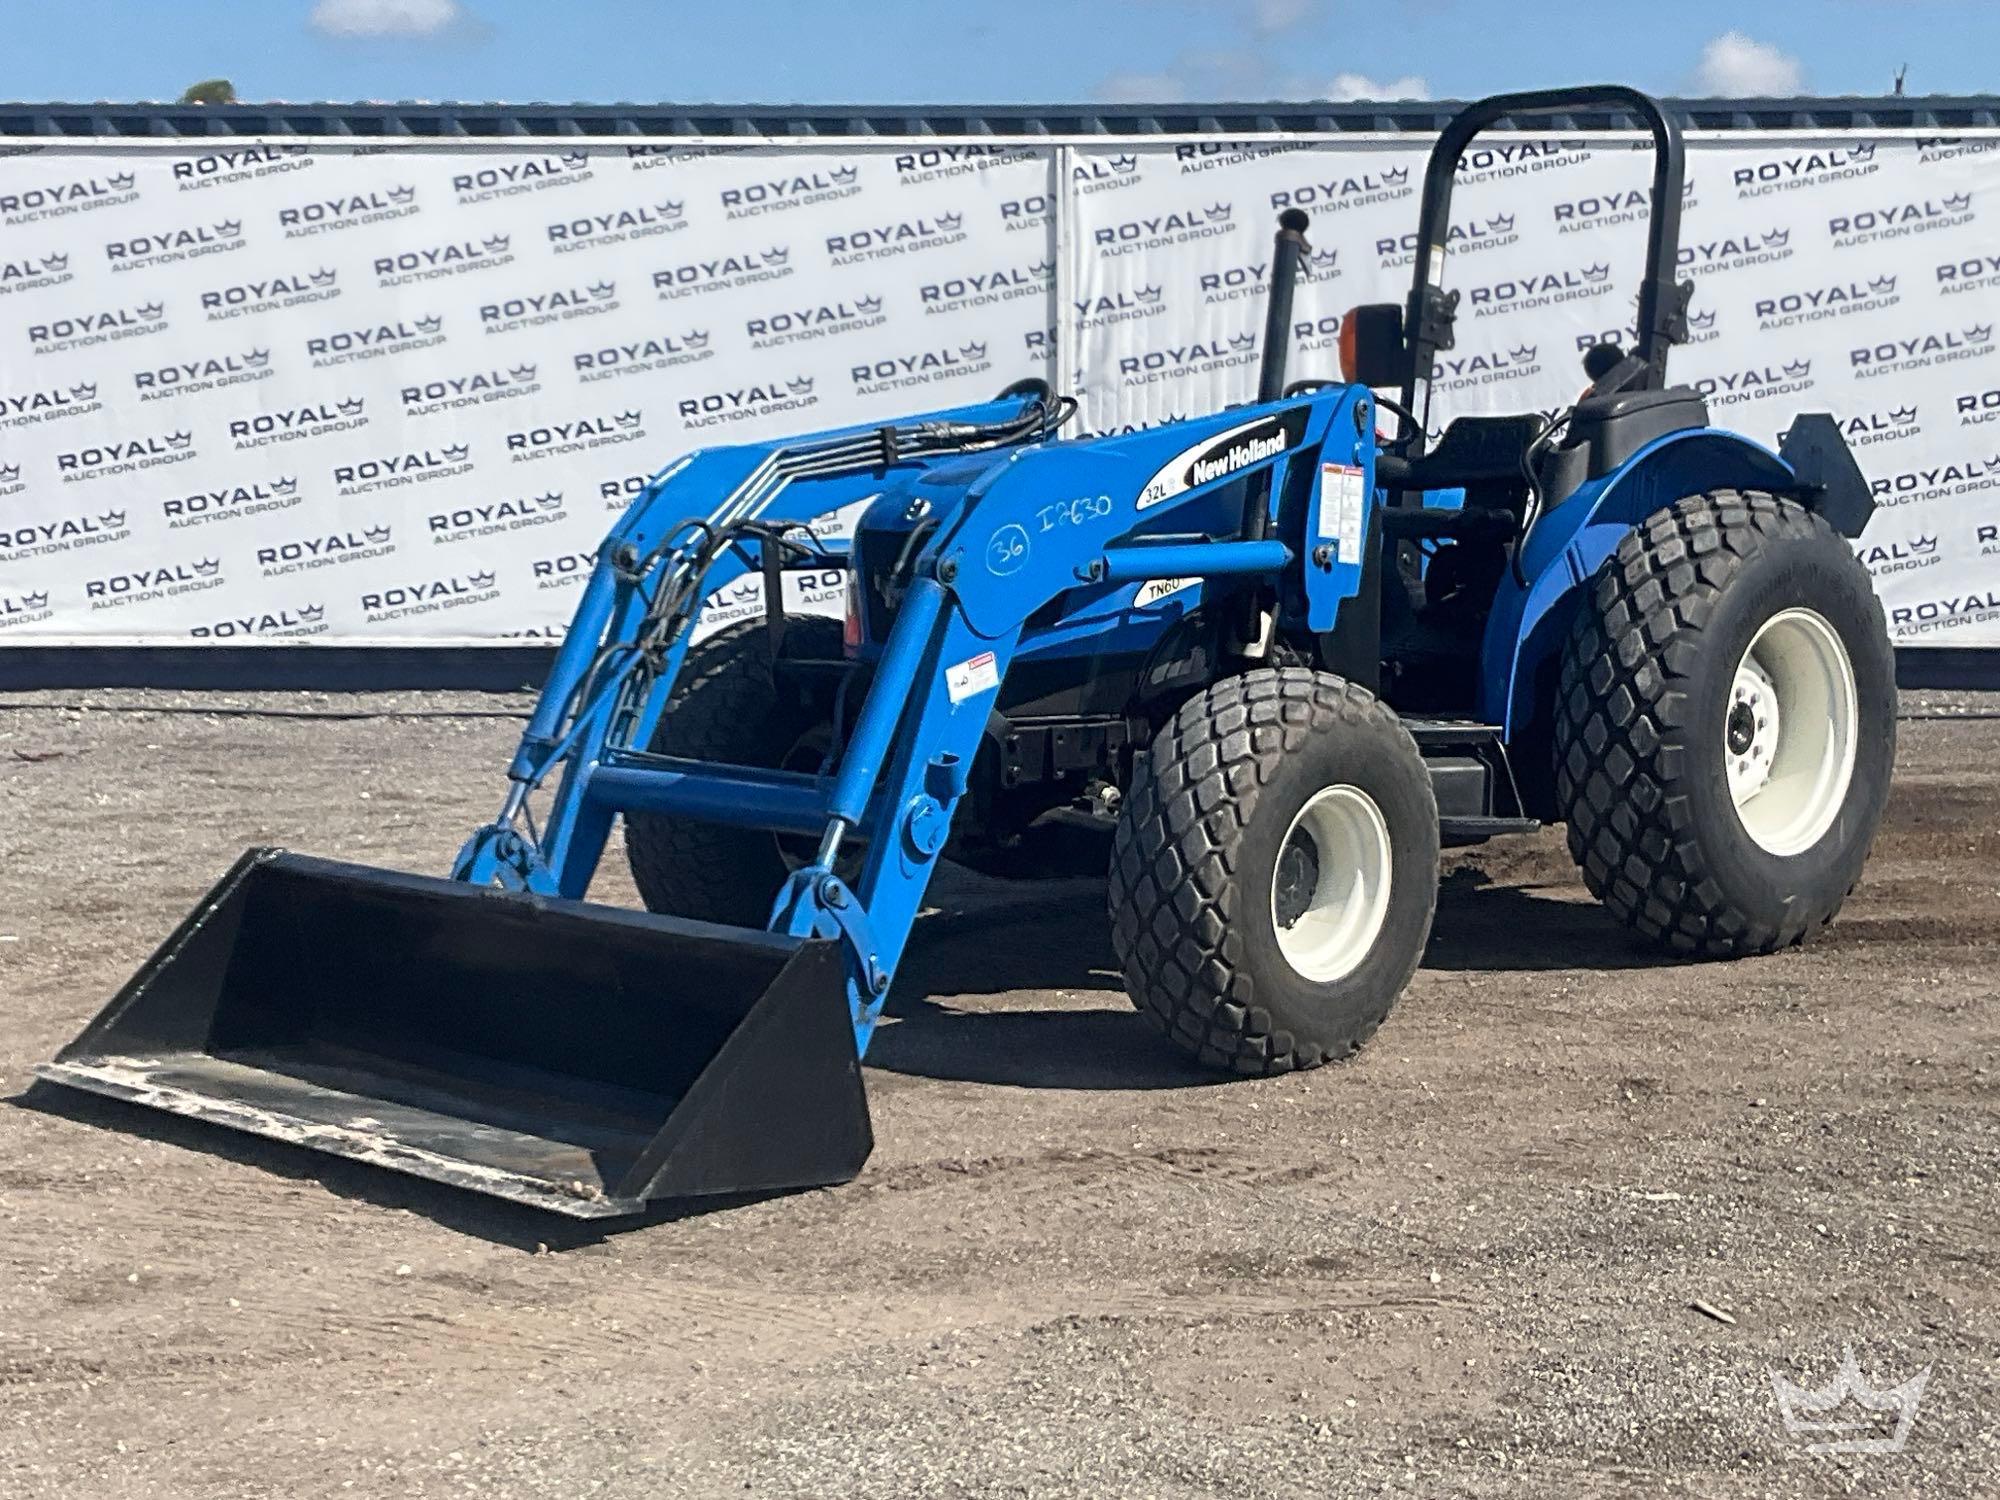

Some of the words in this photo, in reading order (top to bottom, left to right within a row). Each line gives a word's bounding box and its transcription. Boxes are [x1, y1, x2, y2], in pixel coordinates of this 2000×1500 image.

[173, 146, 281, 179] ROYAL
[178, 170, 254, 192] AUCTION
[255, 158, 314, 178] GROUP
[453, 158, 562, 192] ROYAL
[900, 164, 974, 187] AUCTION
[1181, 152, 1255, 175] AUCTION
[1531, 152, 1591, 172] GROUP
[1735, 152, 1846, 186] ROYAL
[0, 180, 108, 213] ROYAL
[458, 183, 534, 205] AUCTION
[535, 171, 594, 190] GROUP
[721, 174, 830, 207] ROYAL
[1083, 175, 1142, 194] GROUP
[1271, 175, 1381, 210] ROYAL
[1353, 187, 1412, 206] GROUP
[1740, 177, 1817, 199] AUCTION
[1819, 164, 1879, 184] GROUP
[4, 204, 80, 226] AUCTION
[81, 192, 140, 212] GROUP
[279, 192, 388, 226] ROYAL
[726, 198, 802, 220] AUCTION
[803, 186, 862, 206] GROUP
[1554, 188, 1653, 221] ROYA
[1829, 200, 1942, 235] ROYAL
[284, 217, 360, 239] AUCTION
[361, 205, 420, 224] GROUP
[548, 208, 656, 241] ROYAL
[553, 232, 628, 254] AUCTION
[630, 220, 689, 240] GROUP
[825, 220, 936, 254] ROYAL
[1094, 211, 1205, 245] ROYAL
[1558, 211, 1633, 234] AUCTION
[1834, 225, 1913, 248] AUCTION
[1914, 213, 1976, 233] GROUP
[106, 226, 214, 260] ROYAL
[111, 251, 186, 273] AUCTION
[188, 239, 247, 258] GROUP
[830, 245, 907, 267] AUCTION
[909, 232, 969, 252] GROUP
[1099, 236, 1176, 258] AUCTION
[1178, 223, 1238, 243] GROUP
[1376, 222, 1487, 257] ROAL
[1459, 234, 1519, 254] GROUP
[1677, 237, 1760, 266] OYAL
[374, 242, 482, 275] ROYAL
[379, 266, 454, 288] AUCTION
[456, 254, 515, 274] GROUP
[653, 254, 762, 288] ROYAL
[1677, 262, 1729, 279] CTION
[1733, 248, 1793, 268] GROUP
[16, 273, 73, 292] GROUP
[201, 276, 310, 309] ROYAL
[658, 279, 734, 301] AUCTION
[735, 267, 794, 286] GROUP
[920, 268, 1028, 302] ROYAL
[1470, 271, 1581, 305] ROYAL
[206, 300, 282, 322] AUCTION
[283, 288, 342, 308] GROUP
[480, 288, 588, 322] ROYAL
[925, 293, 1000, 315] AUCTION
[1075, 293, 1135, 316] YAL
[1108, 304, 1167, 324] GROUP
[1475, 296, 1552, 318] AUCTION
[1554, 283, 1614, 303] GROUP
[1755, 283, 1868, 318] ROYAL
[1760, 308, 1839, 331] AUCTION
[1840, 296, 1902, 316] GROUP
[28, 310, 136, 343] ROYAL
[485, 313, 560, 335] AUCTION
[562, 301, 621, 320] GROUP
[747, 304, 856, 337] ROYAL
[752, 328, 828, 350] AUCTION
[829, 316, 888, 336] GROUP
[33, 334, 108, 356] AUCTION
[110, 322, 169, 342] GROUP
[307, 322, 416, 356] ROYAL
[312, 347, 388, 369] AUCTION
[389, 335, 448, 354] GROUP
[574, 338, 682, 371] ROYAL
[1850, 332, 1963, 367] ROYAL
[134, 356, 242, 389] ROYAL
[579, 362, 654, 384] AUCTION
[656, 350, 715, 370] GROUP
[851, 350, 960, 383] ROYAL
[1119, 341, 1230, 375] ROYAL
[1124, 366, 1201, 388] AUCTION
[1203, 353, 1263, 373] GROUP
[1855, 357, 1934, 380] AUCTION
[1935, 345, 1997, 365] GROUP
[139, 380, 214, 402] AUCTION
[216, 368, 275, 388] GROUP
[401, 370, 510, 404] ROYAL
[856, 374, 932, 396] AUCTION
[933, 362, 992, 382] GROUP
[1482, 366, 1541, 385] GROUP
[1754, 380, 1814, 399] GROUP
[45, 402, 102, 421] GROUP
[406, 395, 482, 417] AUCTION
[483, 383, 542, 402] GROUP
[678, 384, 786, 417] ROYAL
[683, 408, 758, 430] AUCTION
[760, 396, 819, 416] GROUP
[229, 404, 338, 438] ROYAL
[234, 429, 310, 451] AUCTION
[311, 417, 370, 436] GROUP
[507, 417, 613, 450] ROYAL
[1860, 427, 1921, 446] GROUP
[57, 438, 166, 471] ROYAL
[512, 441, 586, 463] AUCTION
[587, 430, 645, 449] GROUP
[1193, 457, 1229, 486] New
[1229, 427, 1286, 471] Holland
[62, 462, 138, 484] AUCTION
[139, 450, 198, 470] GROUP
[334, 450, 442, 484] ROYAL
[339, 475, 414, 497] AUCTION
[416, 463, 475, 482] GROUP
[1871, 463, 1983, 496] ROYAL
[164, 484, 270, 517] ROYAL
[1146, 483, 1167, 503] 32L
[1875, 487, 1951, 508] AUCTION
[169, 508, 243, 530] AUCTION
[244, 497, 302, 516] GROUP
[428, 498, 536, 532] ROYAL
[433, 523, 508, 545] AUCTION
[510, 511, 569, 530] GROUP
[73, 529, 131, 549] GROUP
[258, 532, 364, 565] ROYAL
[991, 536, 1024, 563] 36
[263, 556, 337, 578] AUCTION
[338, 545, 396, 564] GROUP
[1881, 555, 1941, 575] GROUP
[85, 564, 194, 598] ROYAL
[90, 589, 166, 611] AUCTION
[167, 577, 226, 596] GROUP
[361, 578, 470, 611] ROYAL
[366, 602, 442, 624] AUCTION
[443, 590, 502, 610] GROUP
[707, 605, 764, 624] GROUP
[1892, 591, 2000, 624] ROYAL
[1896, 615, 1972, 637] AUCTION
